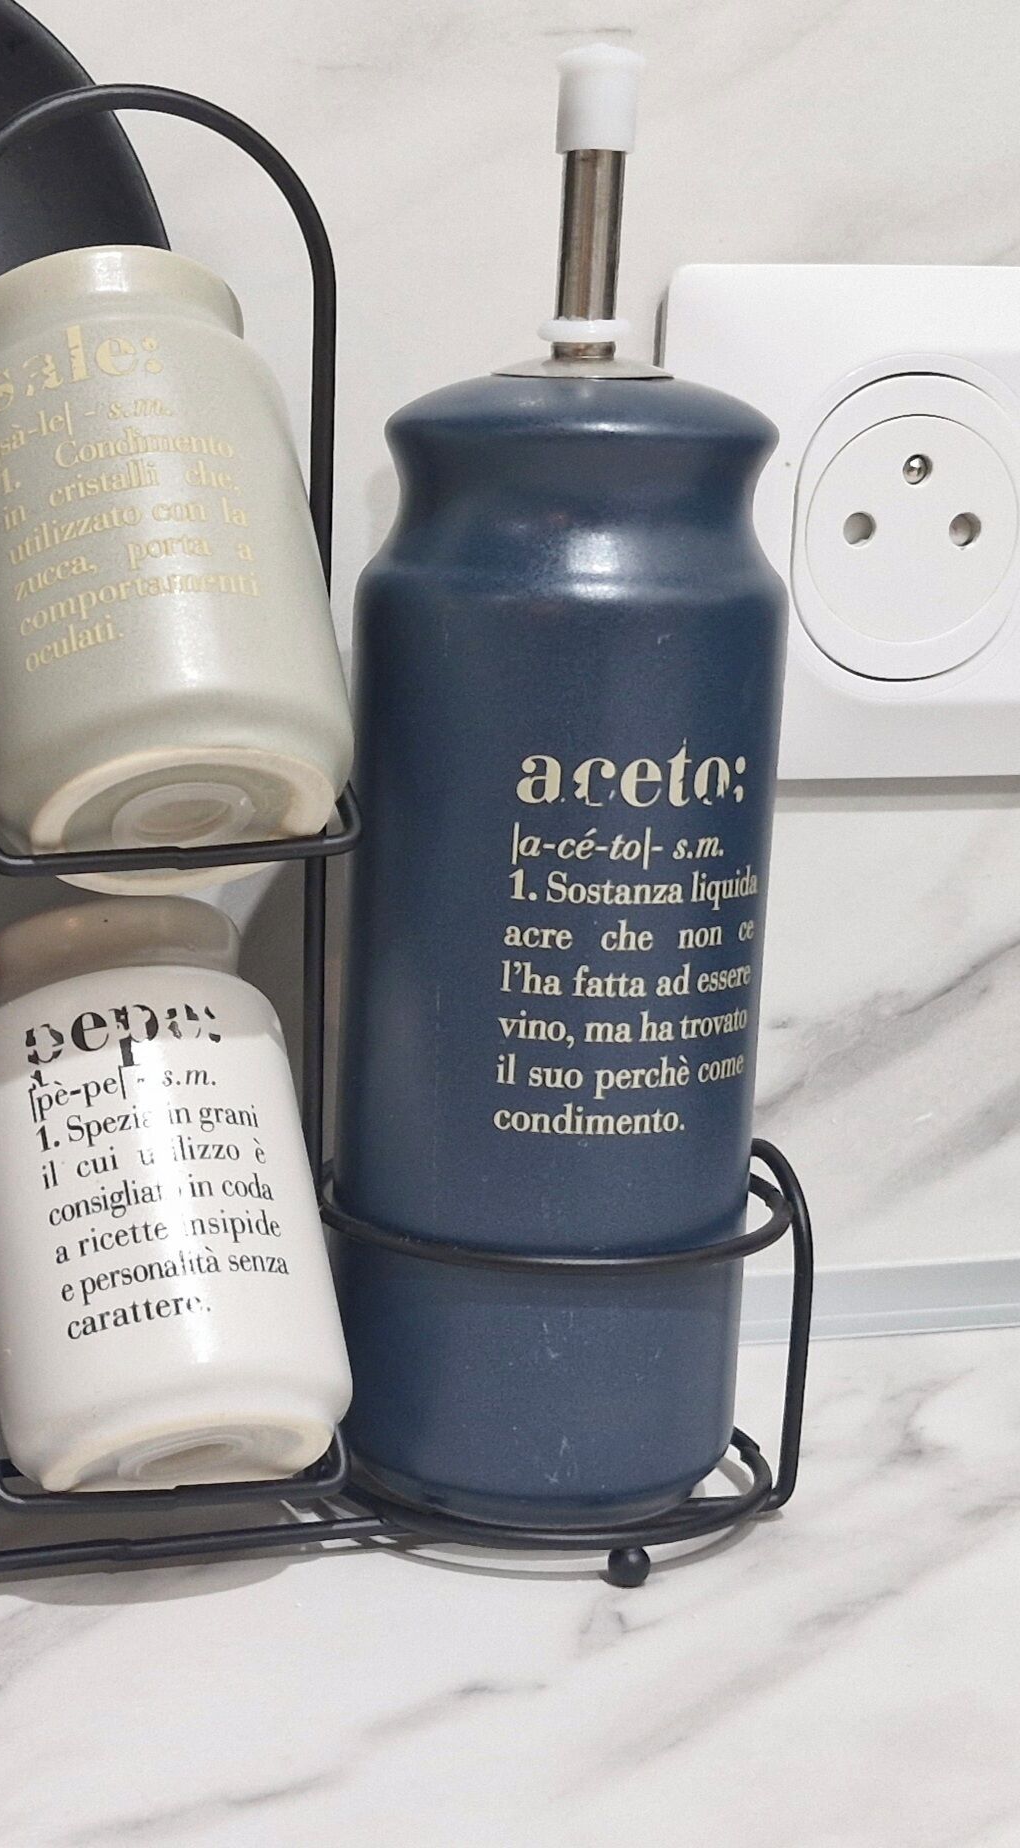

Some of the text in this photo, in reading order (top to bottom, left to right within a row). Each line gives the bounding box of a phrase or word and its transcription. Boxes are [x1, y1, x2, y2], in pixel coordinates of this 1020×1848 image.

[107, 398, 172, 420] s.m.
[0, 426, 234, 494] 1. Condimento
[2, 505, 26, 530] in
[49, 460, 160, 507] cristalli
[9, 496, 248, 565] utilizzato con la
[13, 533, 255, 601] zucca, porta a
[19, 571, 261, 637] comportamenti
[25, 614, 124, 673] oculati.
[672, 840, 724, 859] s.m.
[508, 865, 758, 911] 1. Sostanza liquida
[503, 918, 755, 951] acre che non ce
[500, 960, 751, 998] l'ha fatta ad essere
[497, 1008, 748, 1048] vino, ma ha trovato
[162, 1068, 217, 1088] s.m.
[496, 1053, 744, 1099] il suo perchè come
[36, 1126, 60, 1152] 1.
[168, 1102, 192, 1125] in
[199, 1104, 259, 1132] grani
[493, 1103, 685, 1136] condimento.
[42, 1160, 58, 1190] il
[76, 1146, 118, 1179] cui
[253, 1137, 267, 1164] è
[49, 1172, 274, 1226] consigliat in coda
[55, 1209, 281, 1265] a ricette nsipide
[61, 1246, 290, 1305] e personalità senza
